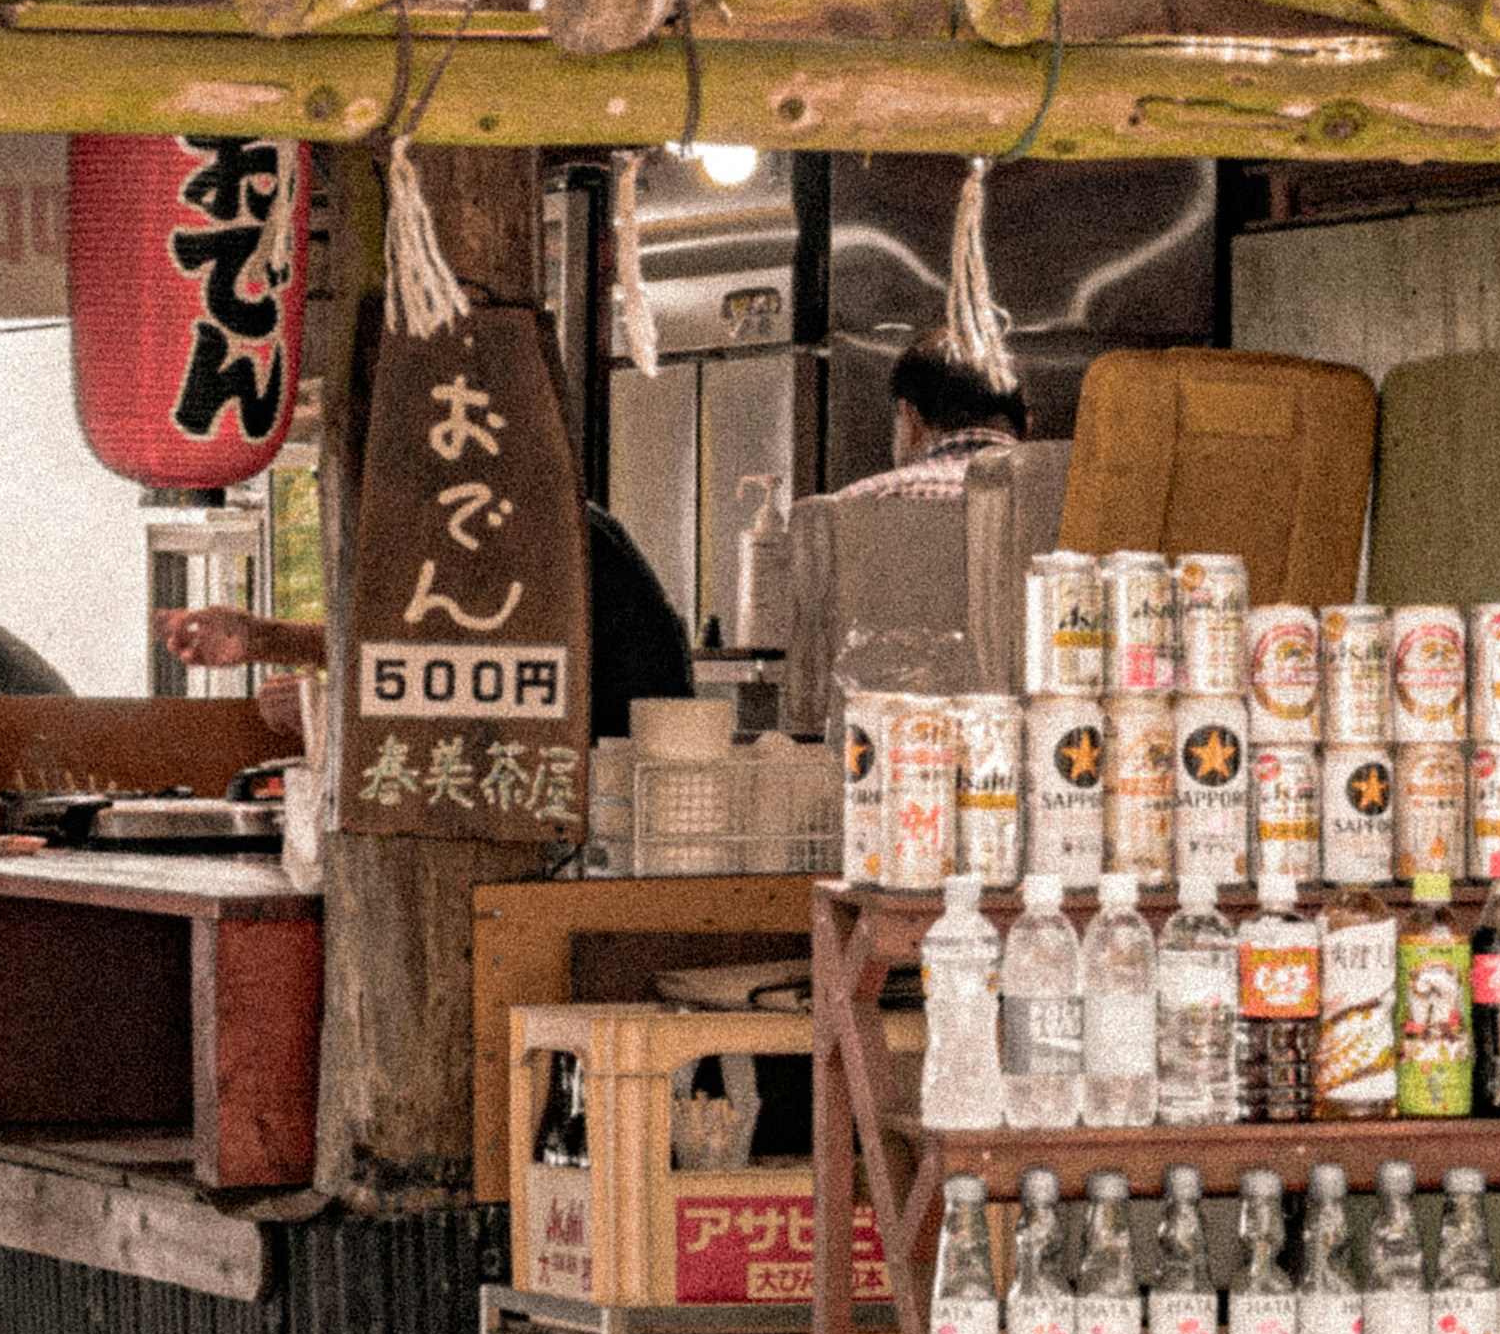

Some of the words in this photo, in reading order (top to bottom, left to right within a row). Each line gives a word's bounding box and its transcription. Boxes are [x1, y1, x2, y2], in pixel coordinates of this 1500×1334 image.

[402, 373, 524, 633] おでん
[373, 657, 557, 706] 500円
[361, 735, 582, 822] 春美茶屋
